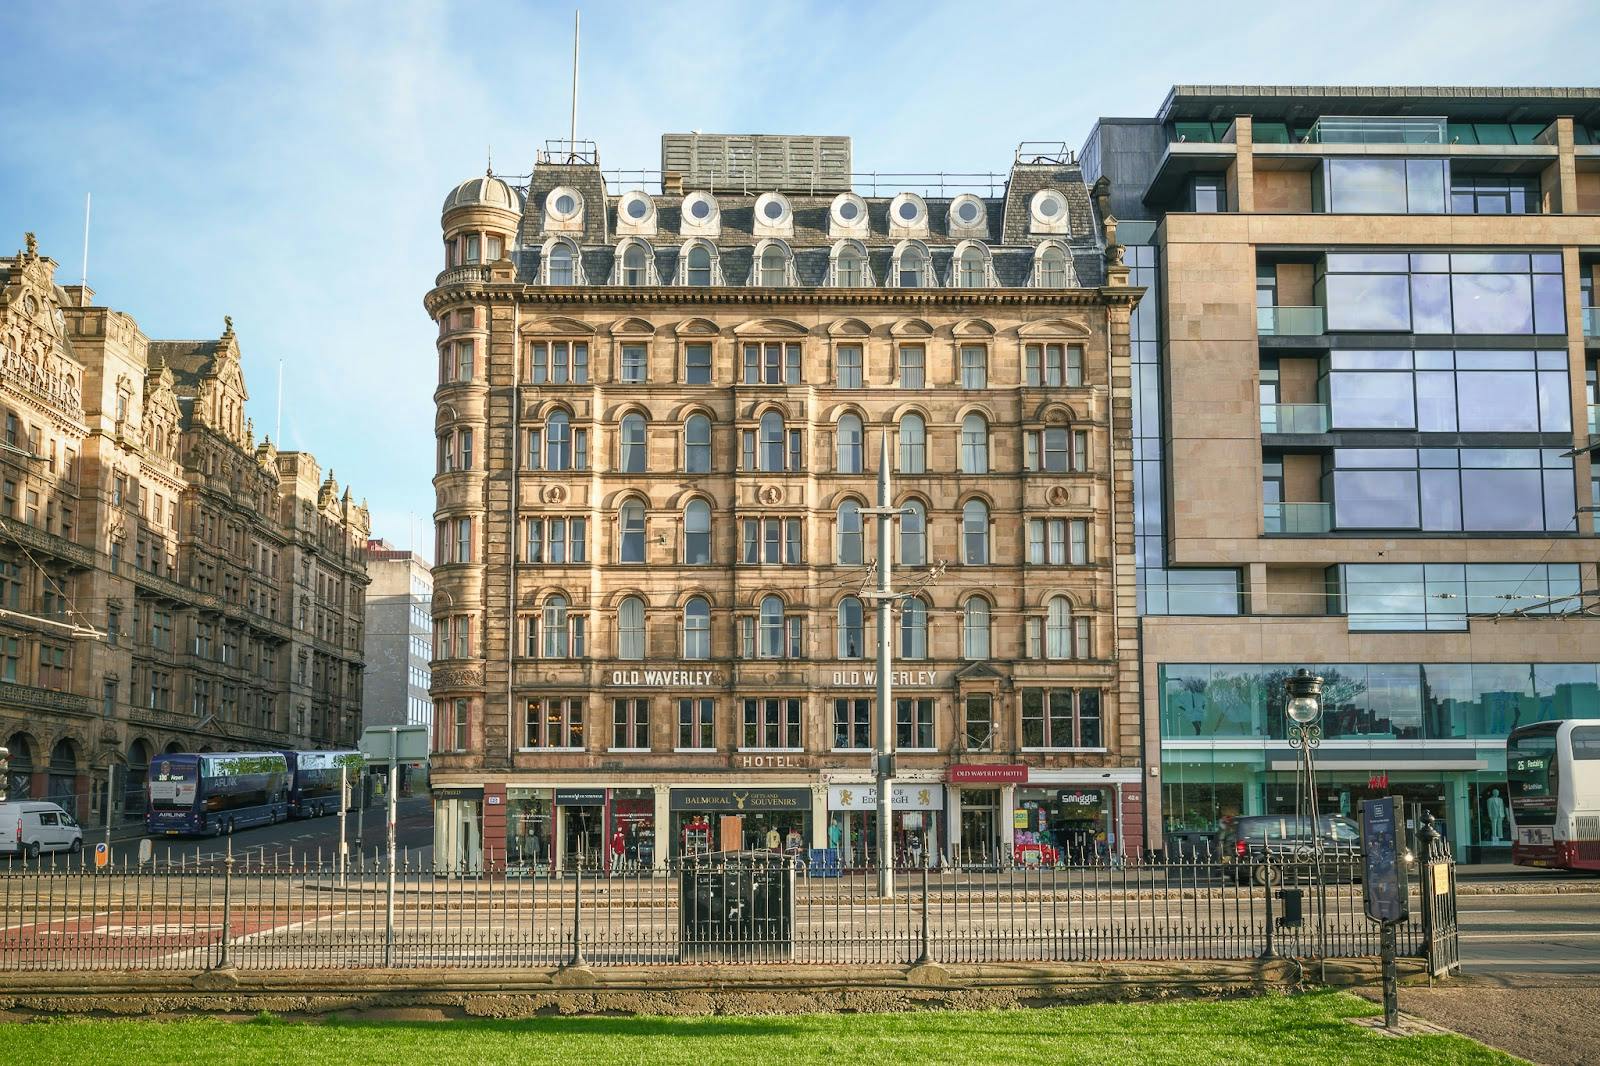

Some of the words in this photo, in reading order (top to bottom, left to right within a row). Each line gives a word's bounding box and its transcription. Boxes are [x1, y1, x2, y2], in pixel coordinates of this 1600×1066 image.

[612, 671, 639, 685] OLD
[644, 671, 713, 686] WAVERLEY
[833, 671, 859, 685] OLD
[863, 671, 937, 685] WERLEY
[1517, 760, 1524, 771] 25
[685, 796, 731, 804] BALMORAL
[751, 798, 797, 806] SOUVENIRS
